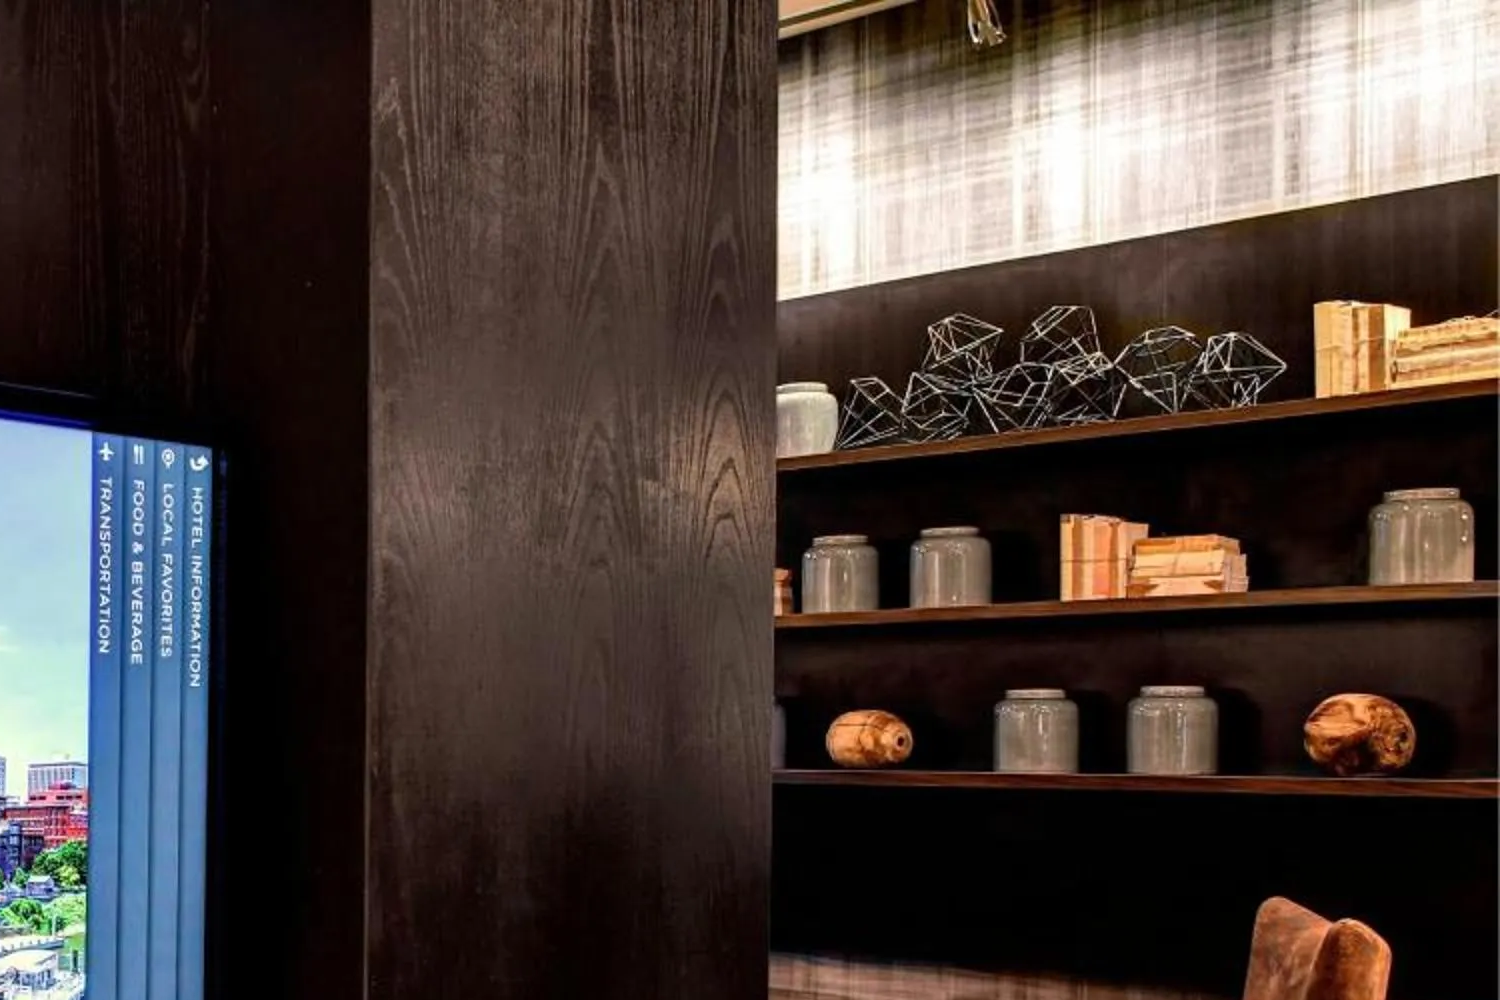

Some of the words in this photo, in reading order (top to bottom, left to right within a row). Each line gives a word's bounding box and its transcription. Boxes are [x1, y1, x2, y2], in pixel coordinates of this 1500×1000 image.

[132, 541, 145, 554] &
[133, 479, 145, 536] FOOD
[162, 483, 175, 547] LOCAL
[191, 488, 203, 549] HOTEL
[98, 477, 112, 654] TRANSPORTATION
[160, 552, 173, 658] FAVORITES
[131, 561, 144, 665] BEVERAGE
[189, 555, 203, 688] INFORMATION
